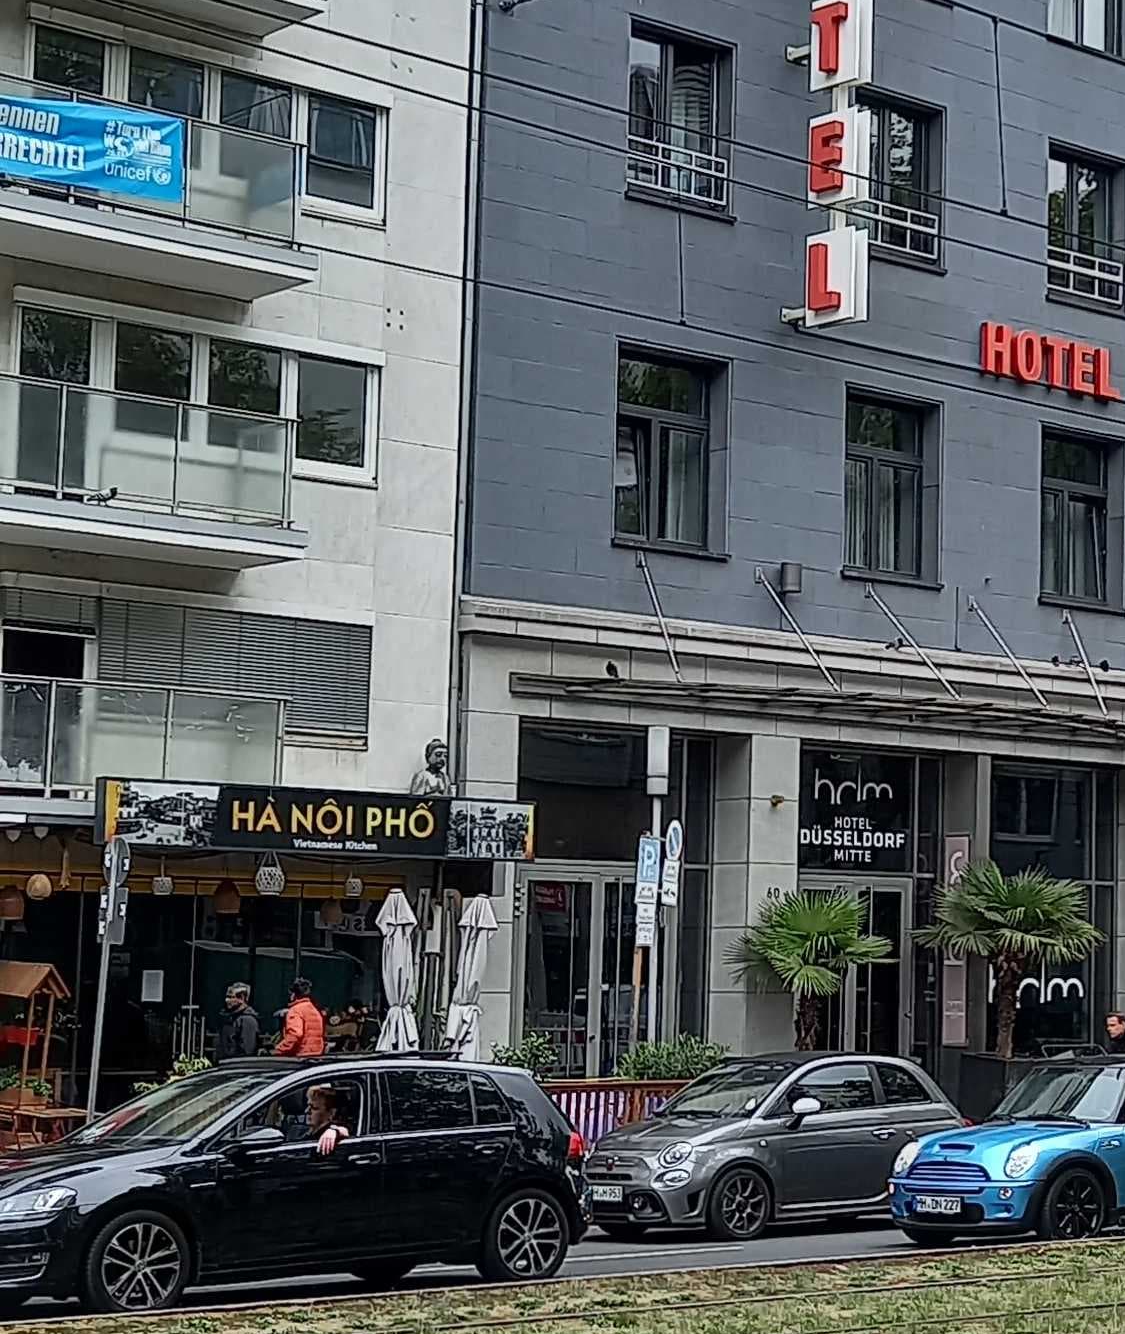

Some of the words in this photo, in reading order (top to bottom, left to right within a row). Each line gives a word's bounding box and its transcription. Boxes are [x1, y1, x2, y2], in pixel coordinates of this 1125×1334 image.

[105, 162, 153, 182] unicef
[980, 321, 1122, 400] HOTEL
[231, 796, 282, 833] HÀ
[291, 798, 354, 839] NỘI
[366, 801, 435, 838] PHỐ
[834, 816, 872, 830] HOTEL
[293, 839, 343, 850] Vietnamese
[345, 840, 378, 851] Kitchen
[800, 824, 905, 848] DÜSSELDORF
[834, 849, 872, 862] MITTE
